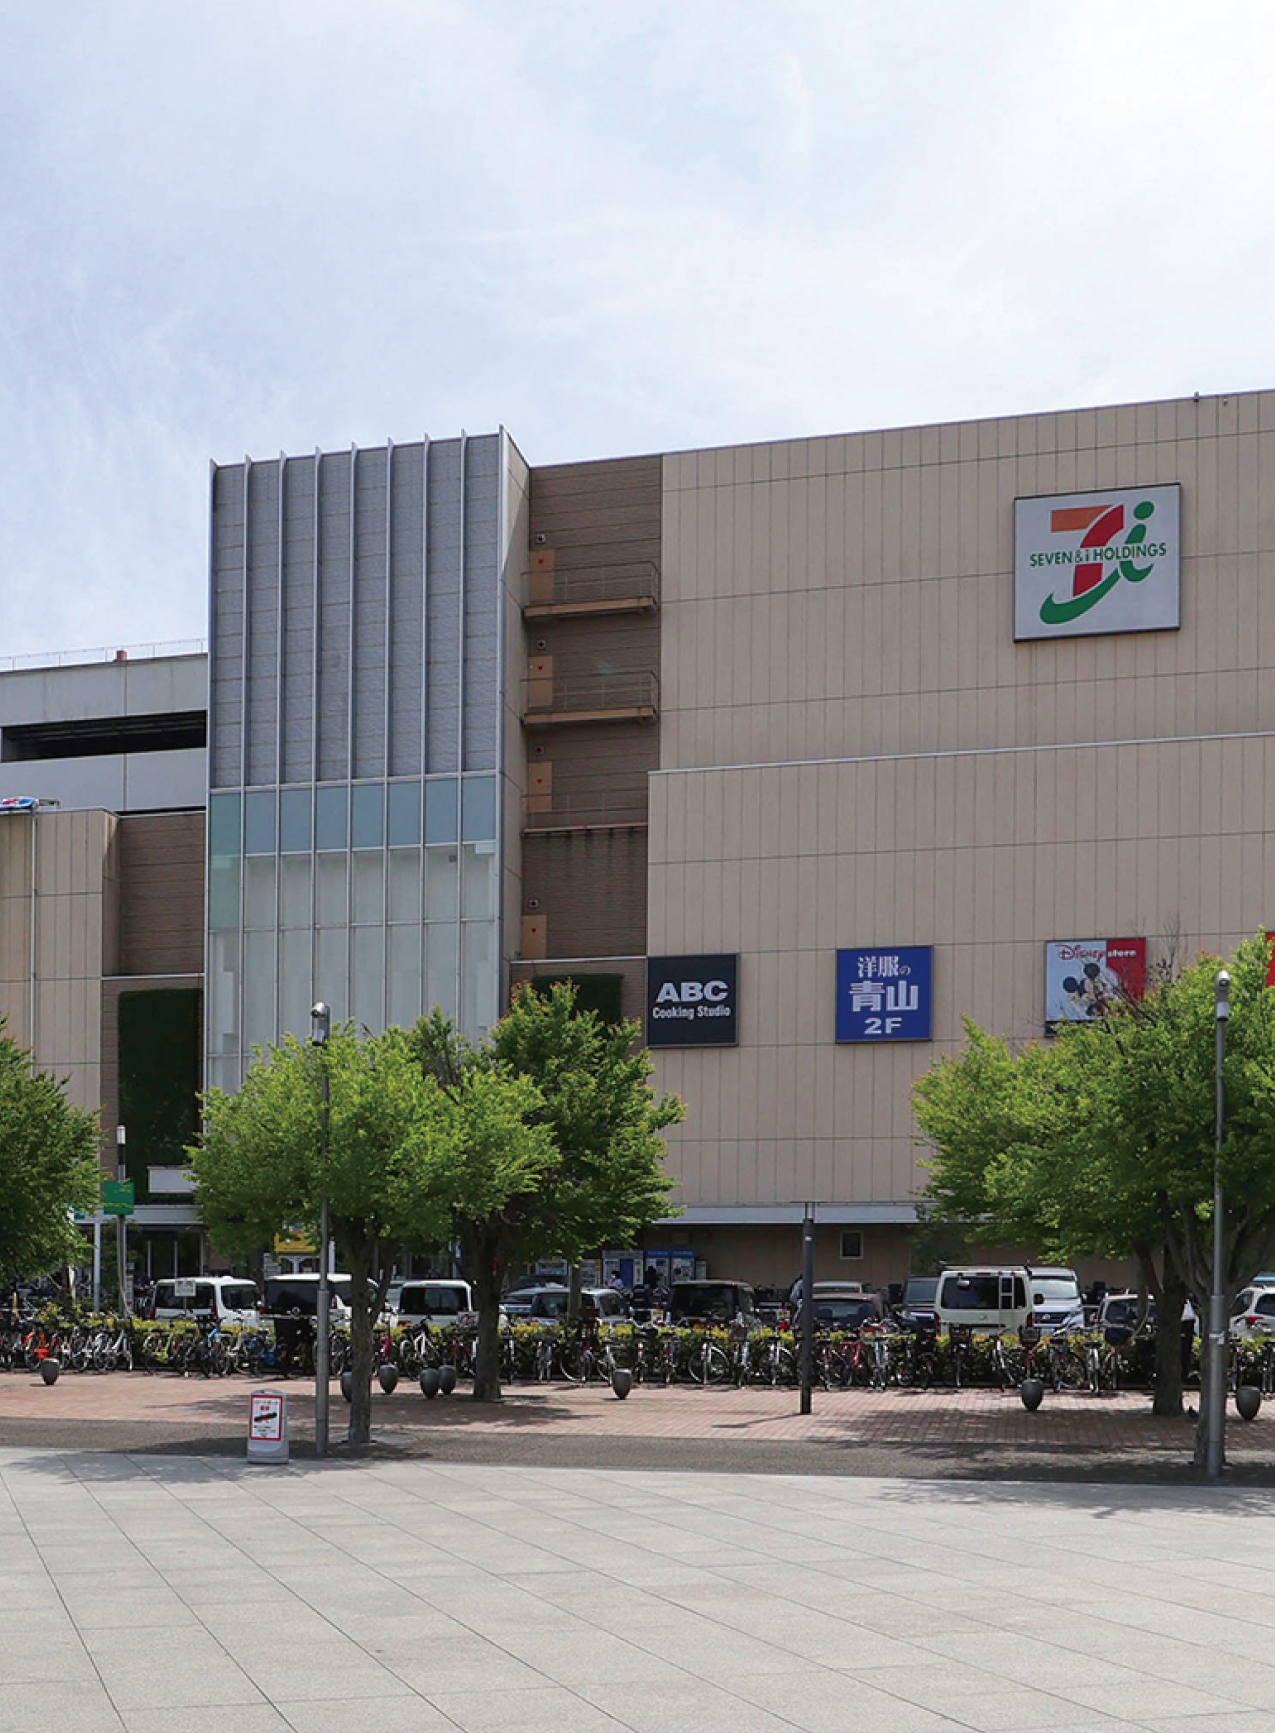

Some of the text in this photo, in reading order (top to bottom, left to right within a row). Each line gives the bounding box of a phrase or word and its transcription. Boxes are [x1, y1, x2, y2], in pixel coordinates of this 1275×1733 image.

[1093, 543, 1167, 561] HOLDINGS
[857, 956, 911, 978] 洋服の
[655, 980, 729, 1003] ABC
[850, 980, 919, 1012] 青山
[652, 1004, 731, 1020] Cooking Studio
[864, 1017, 902, 1034] 2F
